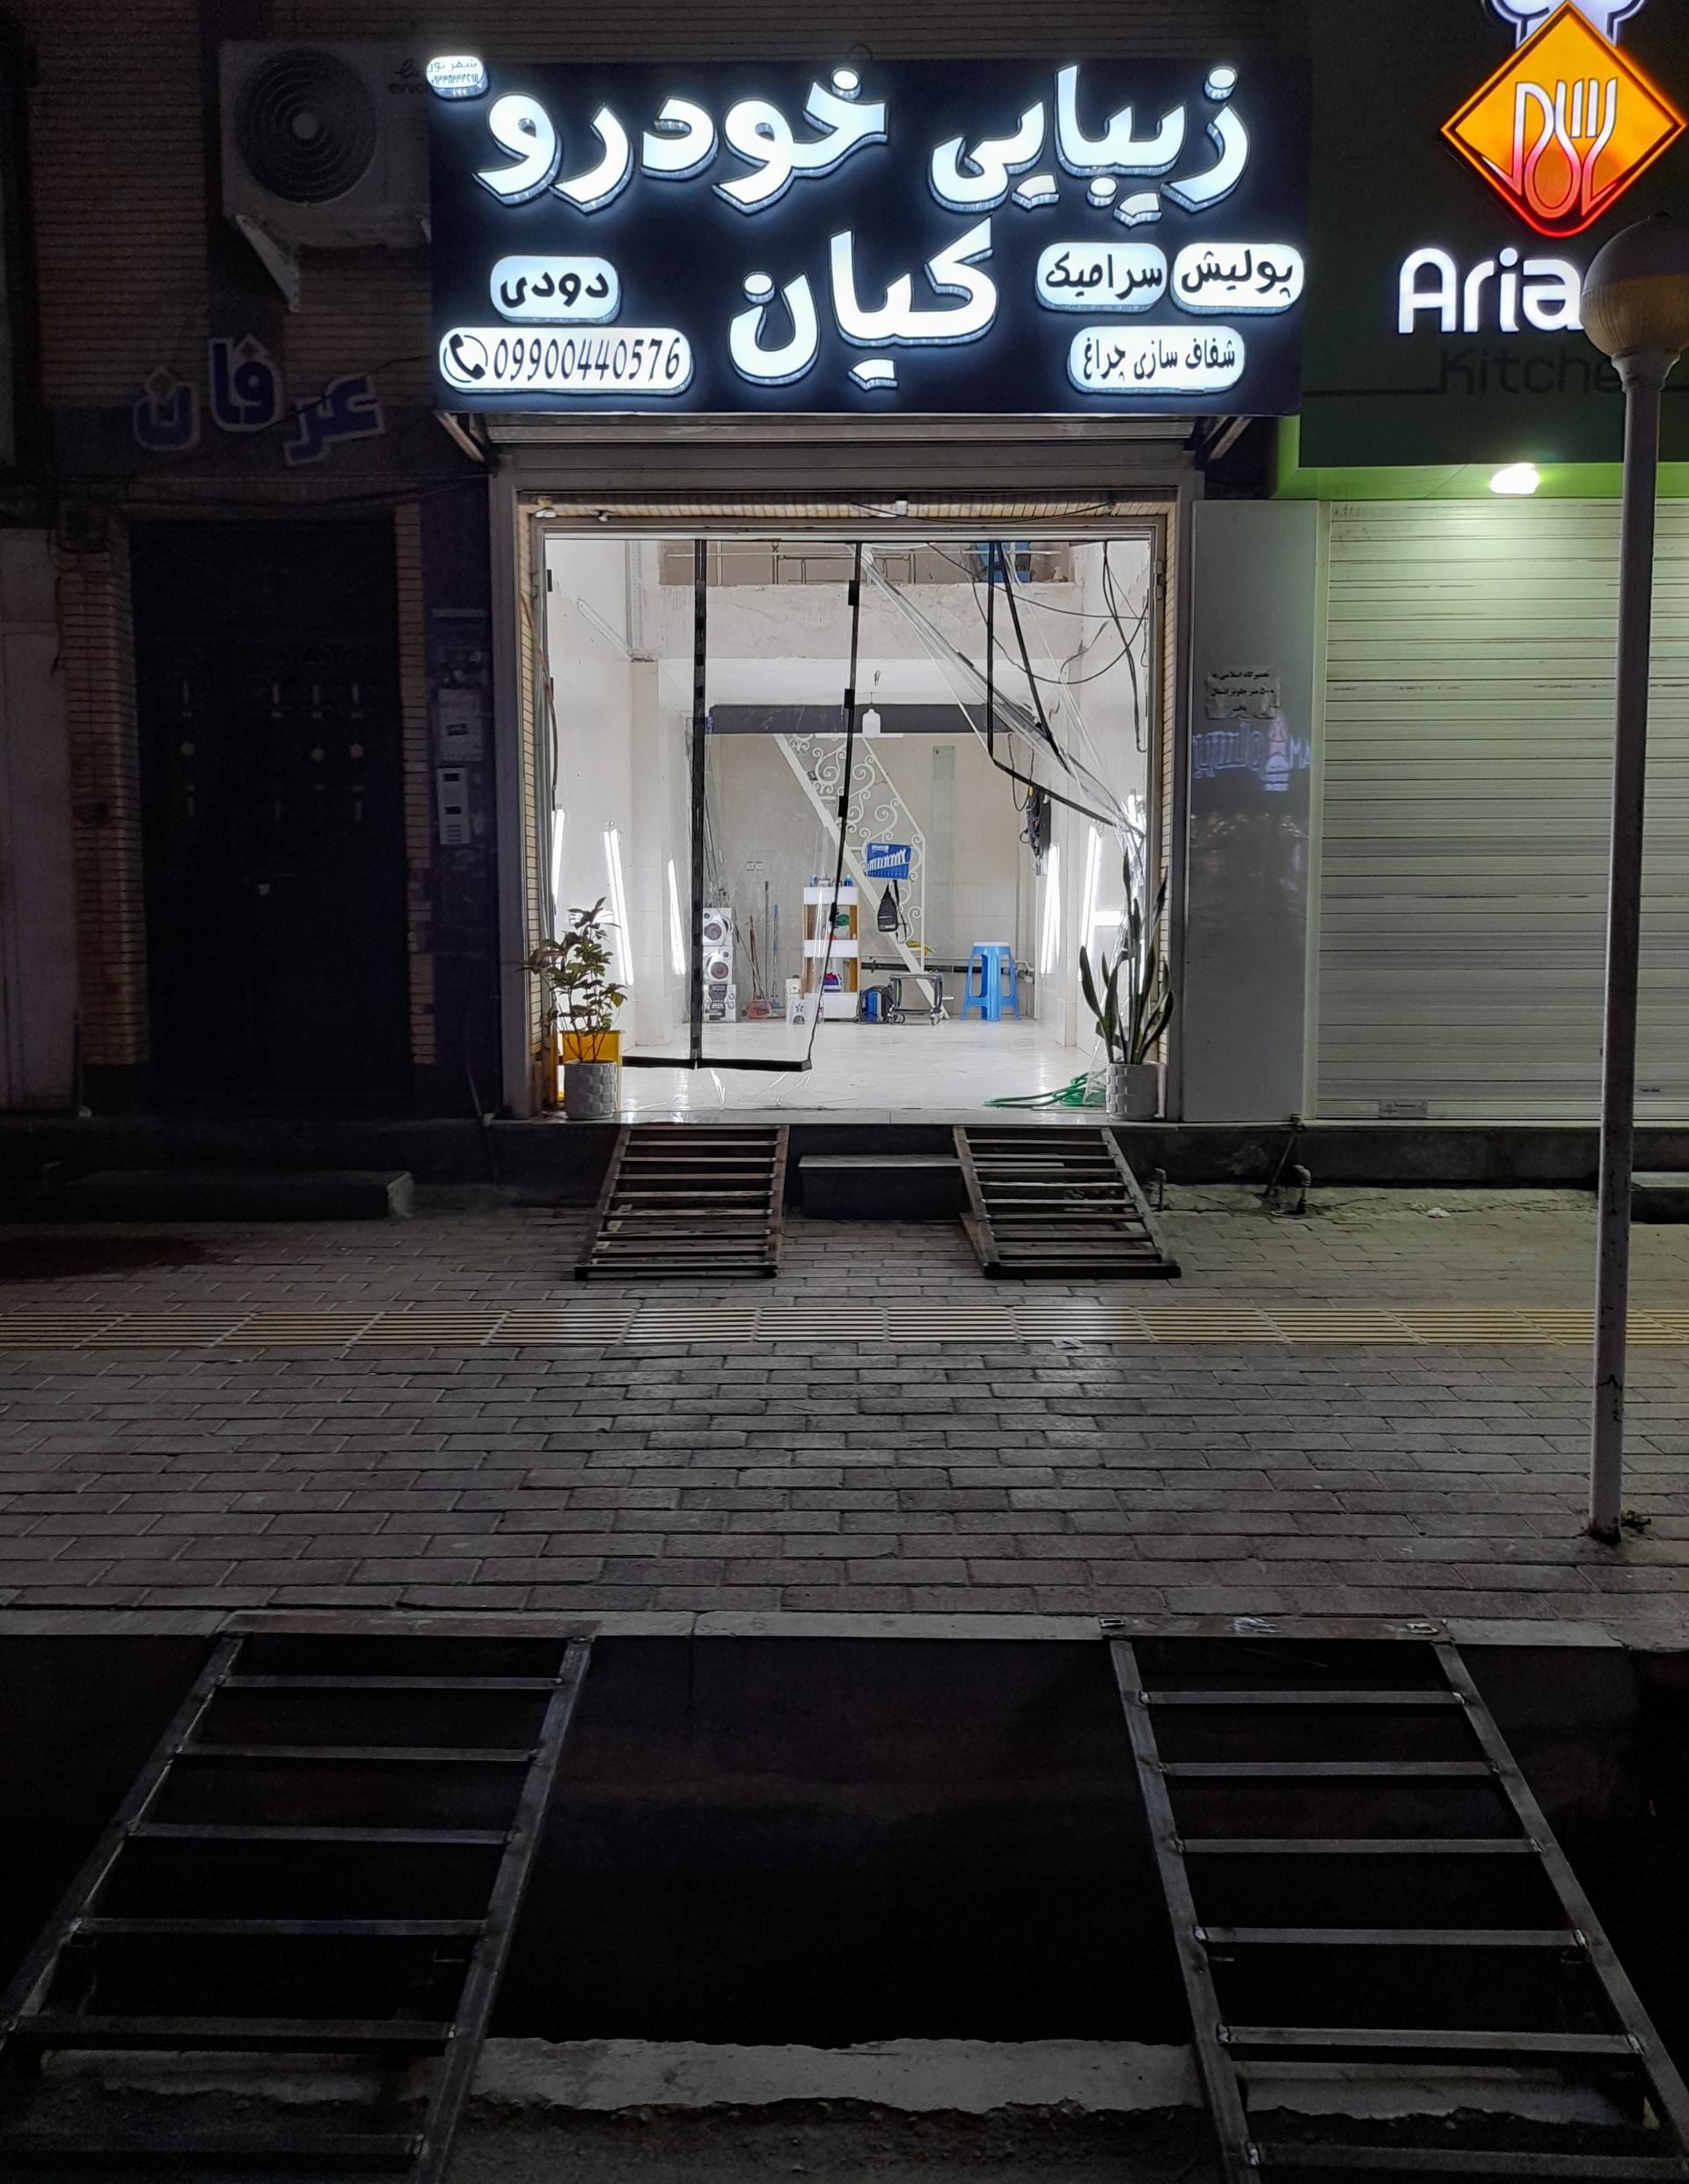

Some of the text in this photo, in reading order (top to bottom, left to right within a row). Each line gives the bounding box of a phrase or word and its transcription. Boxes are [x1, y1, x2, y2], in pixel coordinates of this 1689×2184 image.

[472, 64, 1249, 228] زیبایی خودرو
[500, 271, 610, 308] دودی
[1044, 251, 1163, 300] سرامیک
[1181, 249, 1294, 297] پولیش
[1398, 247, 1584, 334] Aria
[728, 214, 998, 390] کیان
[493, 337, 681, 382] 09900440576
[1083, 332, 1236, 382] شفاف سازی چراغ
[1437, 347, 1621, 394] Kitche
